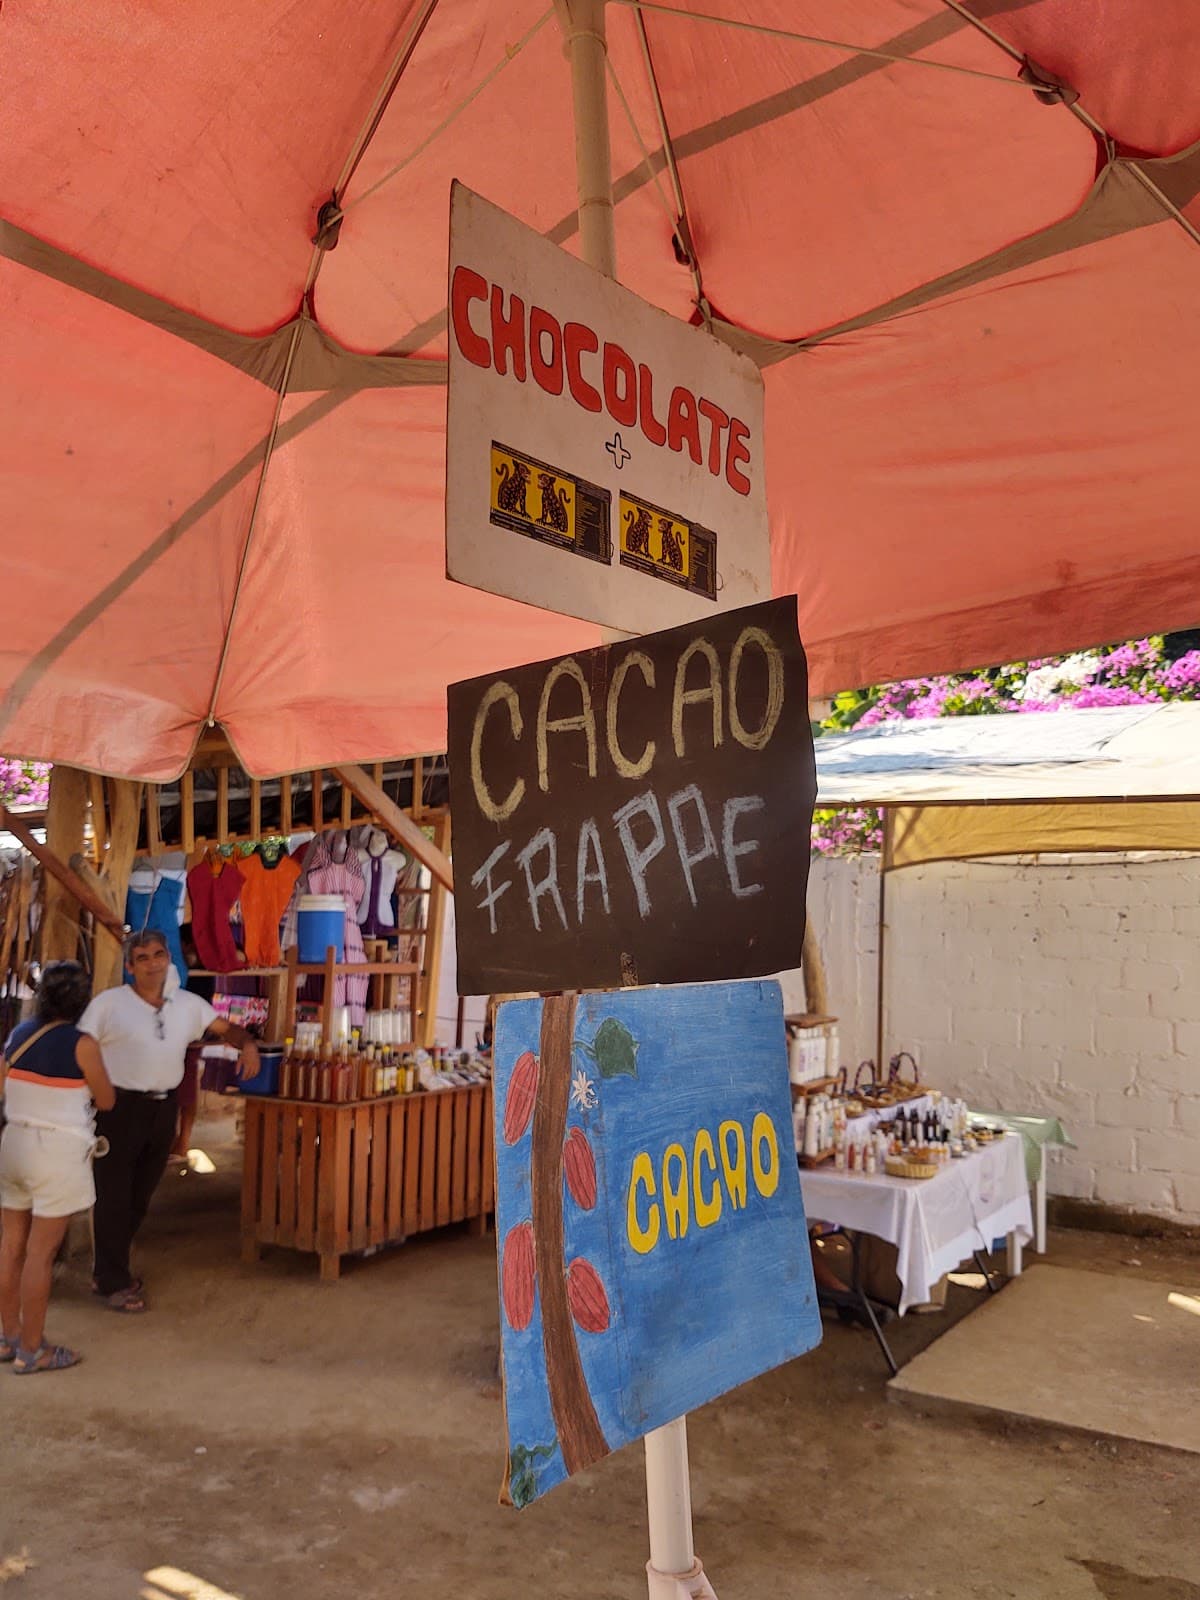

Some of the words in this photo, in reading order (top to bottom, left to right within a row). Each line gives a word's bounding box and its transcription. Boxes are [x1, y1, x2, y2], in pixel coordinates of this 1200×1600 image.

[451, 265, 751, 496] CHOCOLATE
[470, 626, 785, 822] CACAO
[471, 783, 766, 934] FRAPPE
[626, 1112, 780, 1254] CACAO
